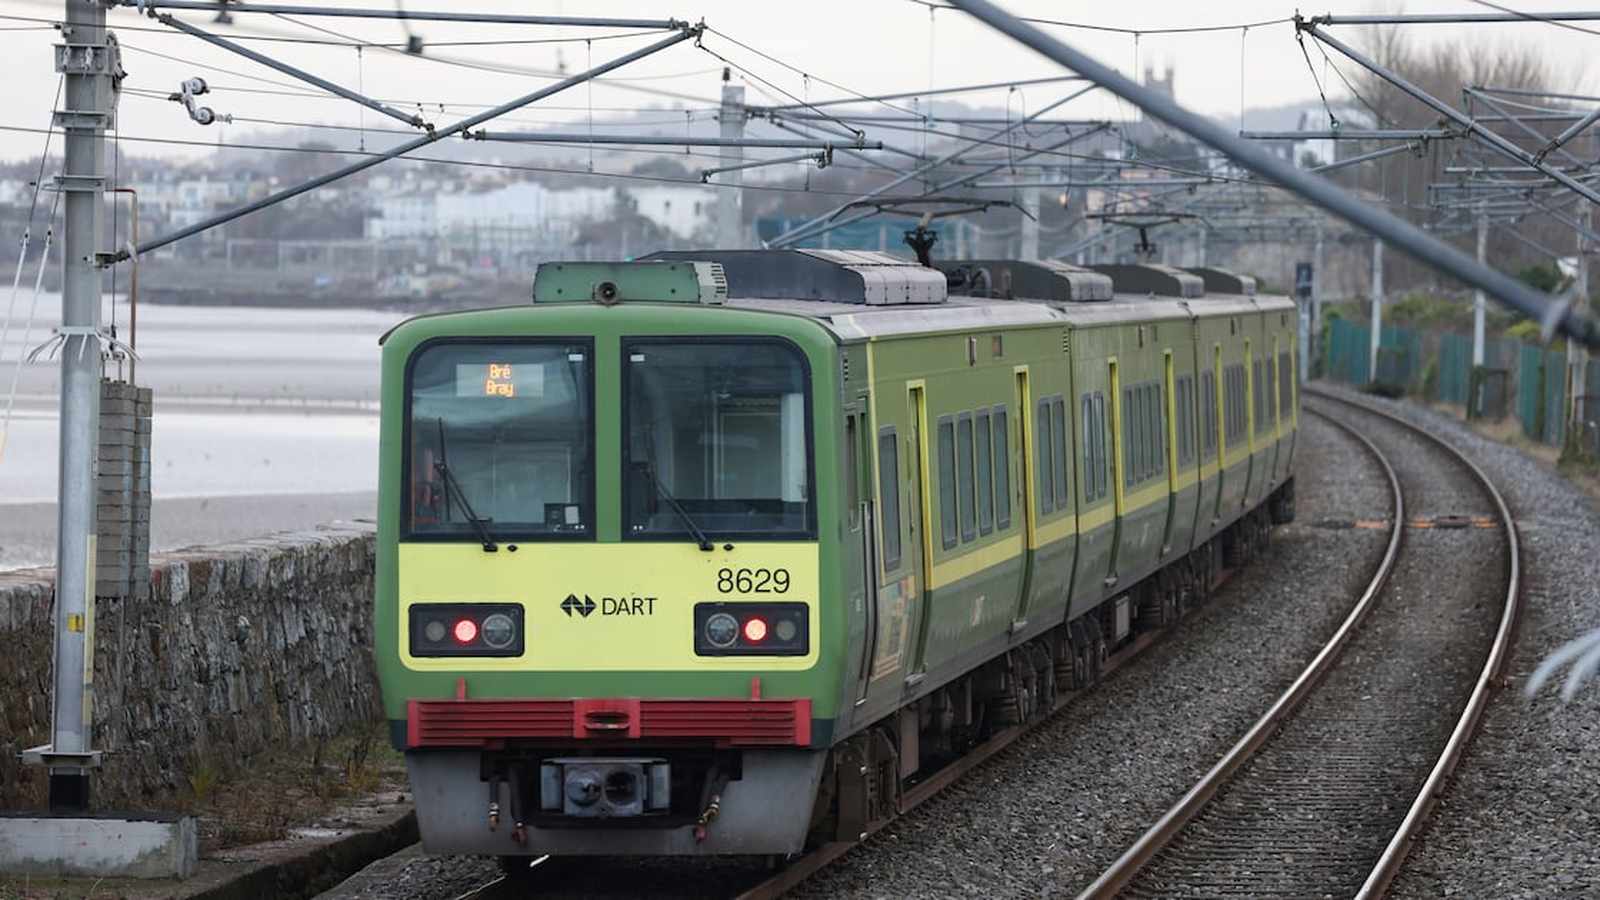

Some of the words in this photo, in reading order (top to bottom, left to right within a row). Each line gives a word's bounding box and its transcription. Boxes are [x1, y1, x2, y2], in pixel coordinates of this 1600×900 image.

[490, 364, 512, 379] Bré
[486, 380, 514, 397] Bray
[717, 568, 790, 593] 8629
[602, 597, 658, 615] DART
